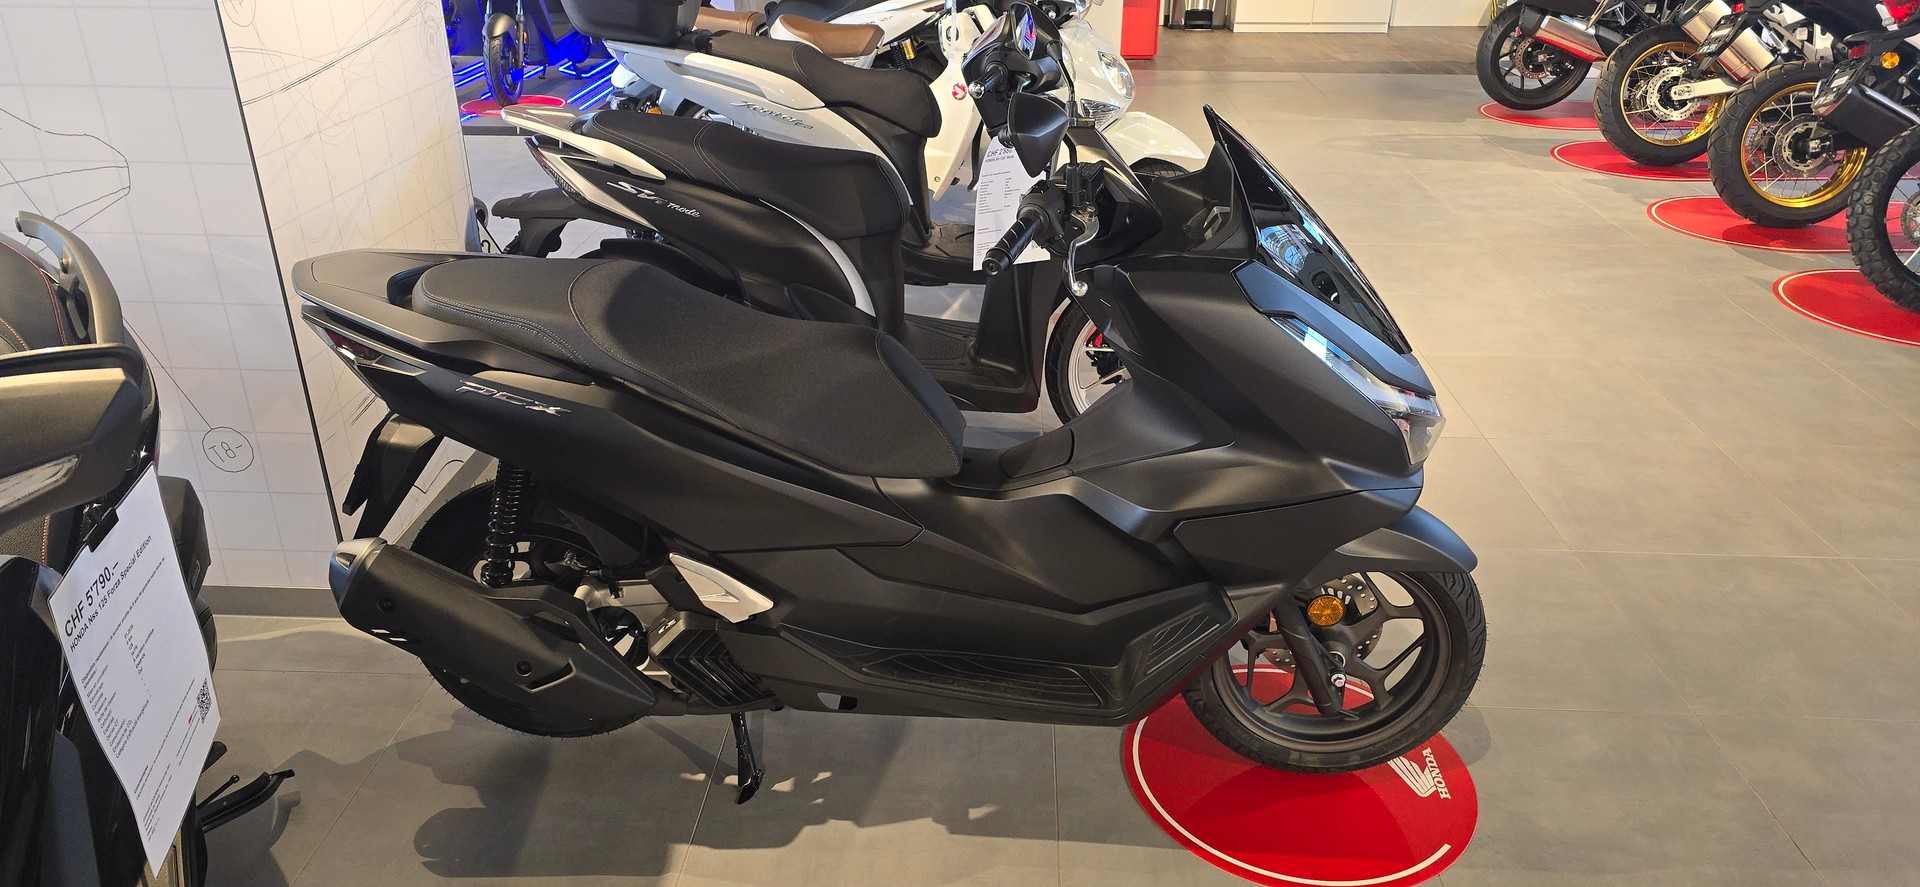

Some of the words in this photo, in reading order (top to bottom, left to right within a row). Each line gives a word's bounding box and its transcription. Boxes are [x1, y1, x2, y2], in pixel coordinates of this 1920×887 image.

[666, 202, 701, 218] mode
[456, 379, 572, 417] PCX
[70, 623, 88, 652] HONDA
[88, 610, 98, 625] Nss
[98, 595, 107, 610] 125
[107, 579, 121, 598] Forza
[120, 555, 136, 580] Special
[136, 536, 151, 558] Edition
[65, 600, 84, 637] CHF
[1421, 747, 1451, 799] HONDA
